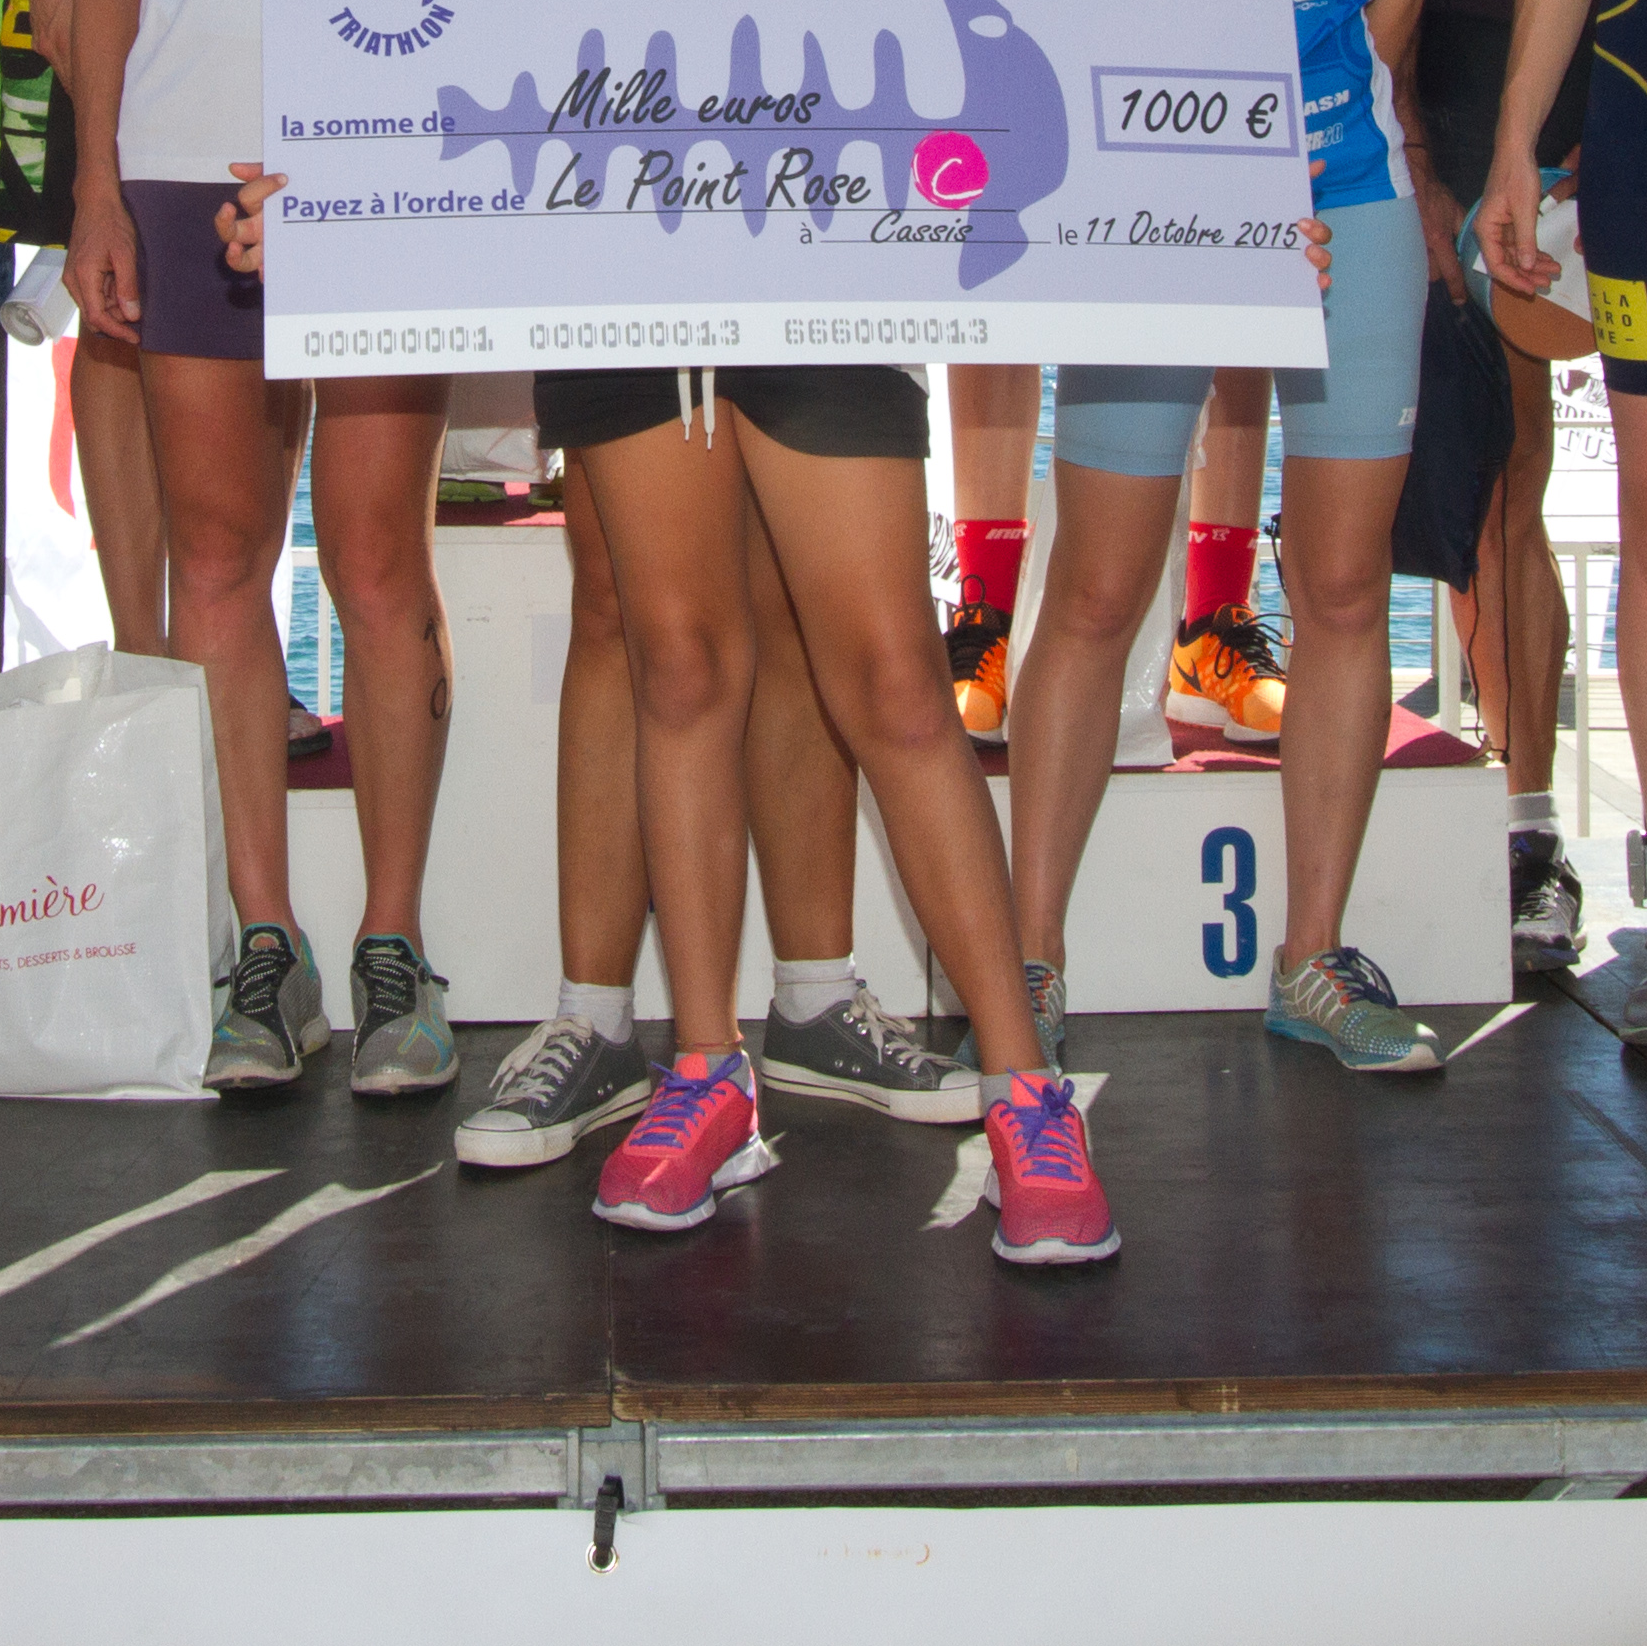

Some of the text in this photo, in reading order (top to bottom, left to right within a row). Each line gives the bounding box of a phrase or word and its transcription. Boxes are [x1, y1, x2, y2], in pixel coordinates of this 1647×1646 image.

[328, 3, 455, 56] TRIATHLON
[281, 111, 456, 137] la somme de
[548, 66, 821, 133] Mille euros
[1120, 88, 1228, 134] 1000
[1246, 92, 1279, 139] €
[545, 146, 871, 211] Le Point Rose
[282, 189, 527, 223] Payez à l'ordre de
[799, 210, 1299, 249] à Cassis le 11 Octobre 2015
[1201, 826, 1258, 979] 3
[17, 948, 70, 969] DESSERTS
[73, 947, 82, 960] &
[85, 942, 137, 959] BROUSSE
